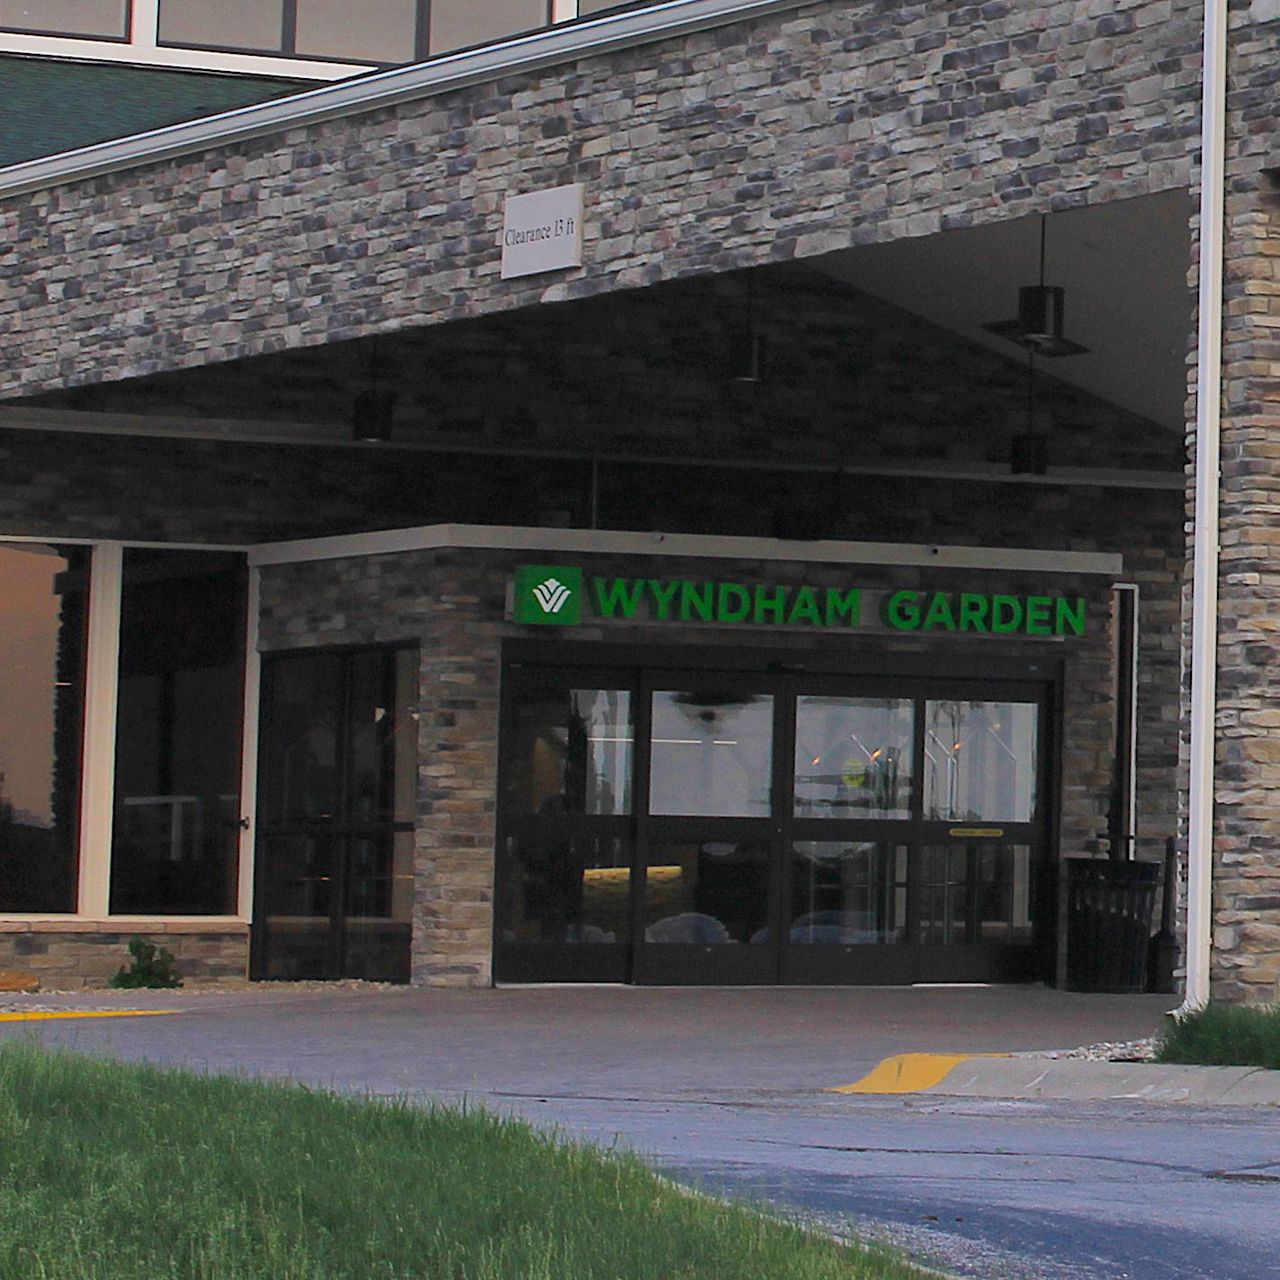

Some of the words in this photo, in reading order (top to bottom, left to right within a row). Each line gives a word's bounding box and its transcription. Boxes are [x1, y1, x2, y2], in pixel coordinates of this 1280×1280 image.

[505, 226, 551, 246] Clearance
[592, 577, 861, 626] WYNDHAM
[886, 590, 1086, 637] GARDEN
